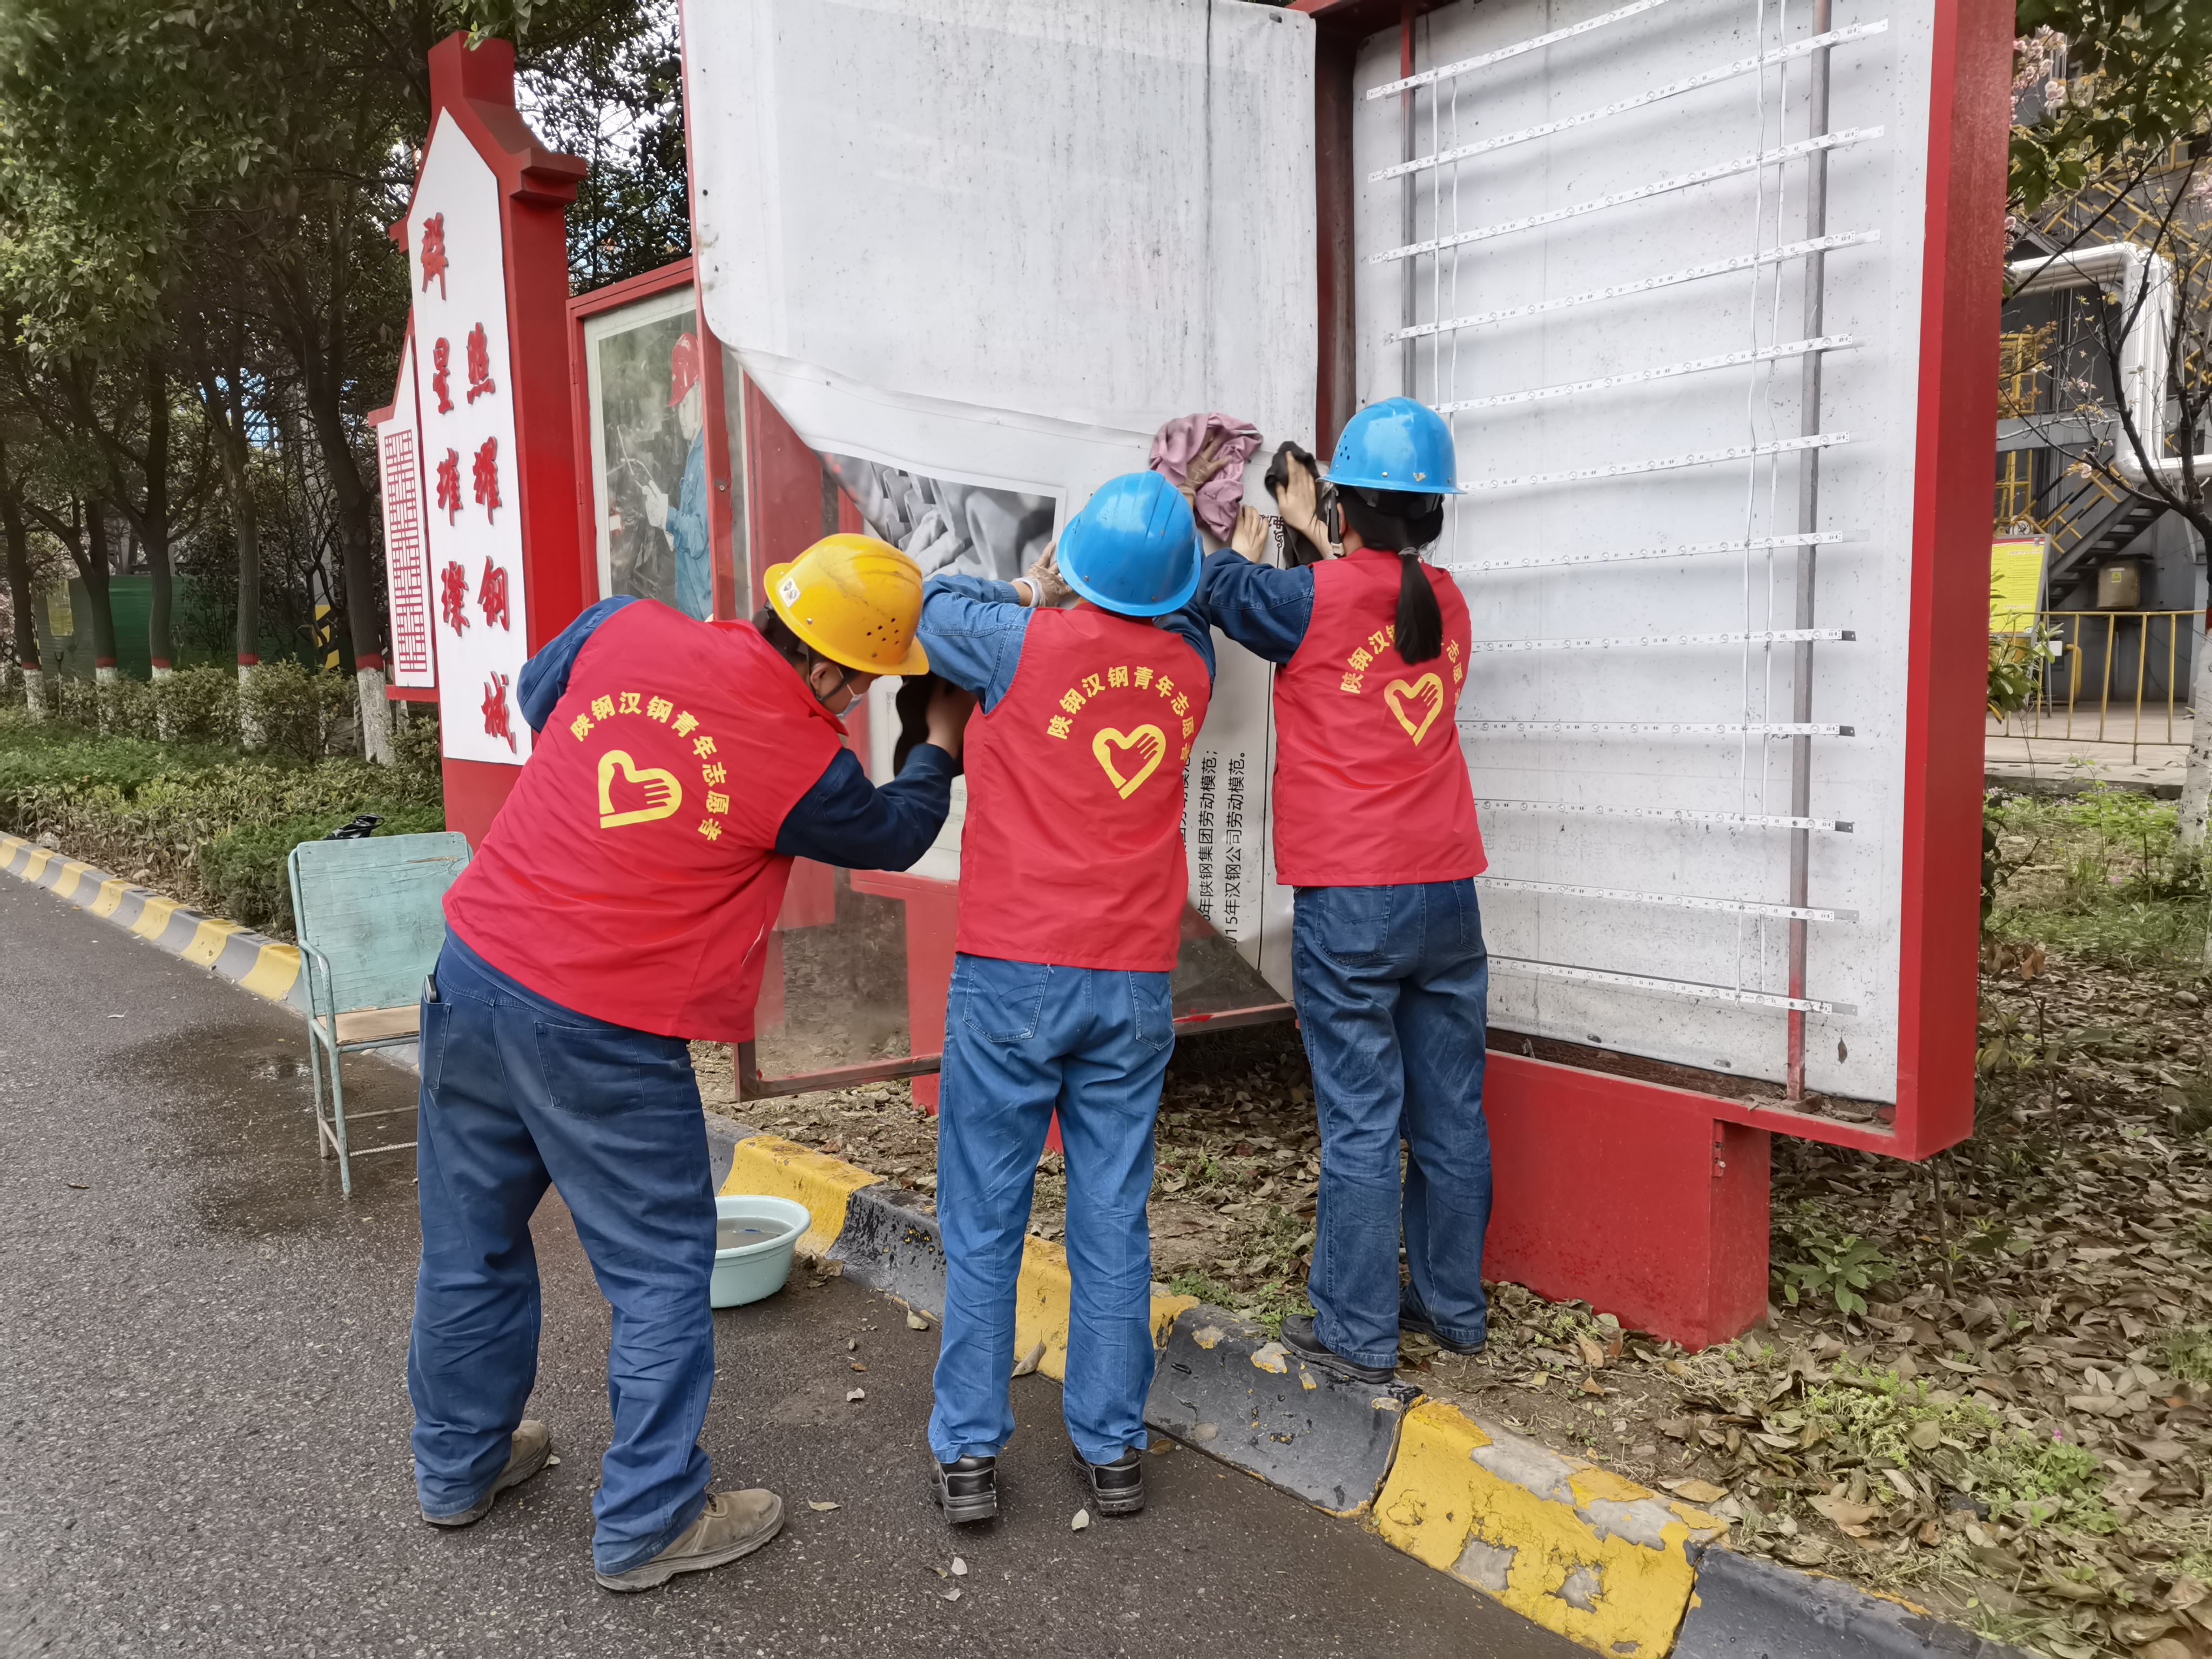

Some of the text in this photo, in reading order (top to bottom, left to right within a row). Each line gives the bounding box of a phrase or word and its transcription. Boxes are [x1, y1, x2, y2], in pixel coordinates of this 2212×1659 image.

[570, 691, 730, 841] 陕钢汉钢青年志愿者
[1047, 666, 1194, 762] 陕钢汉钢青年志愿者
[1224, 752, 1245, 949] 015年汉钢公司劳动模范。
